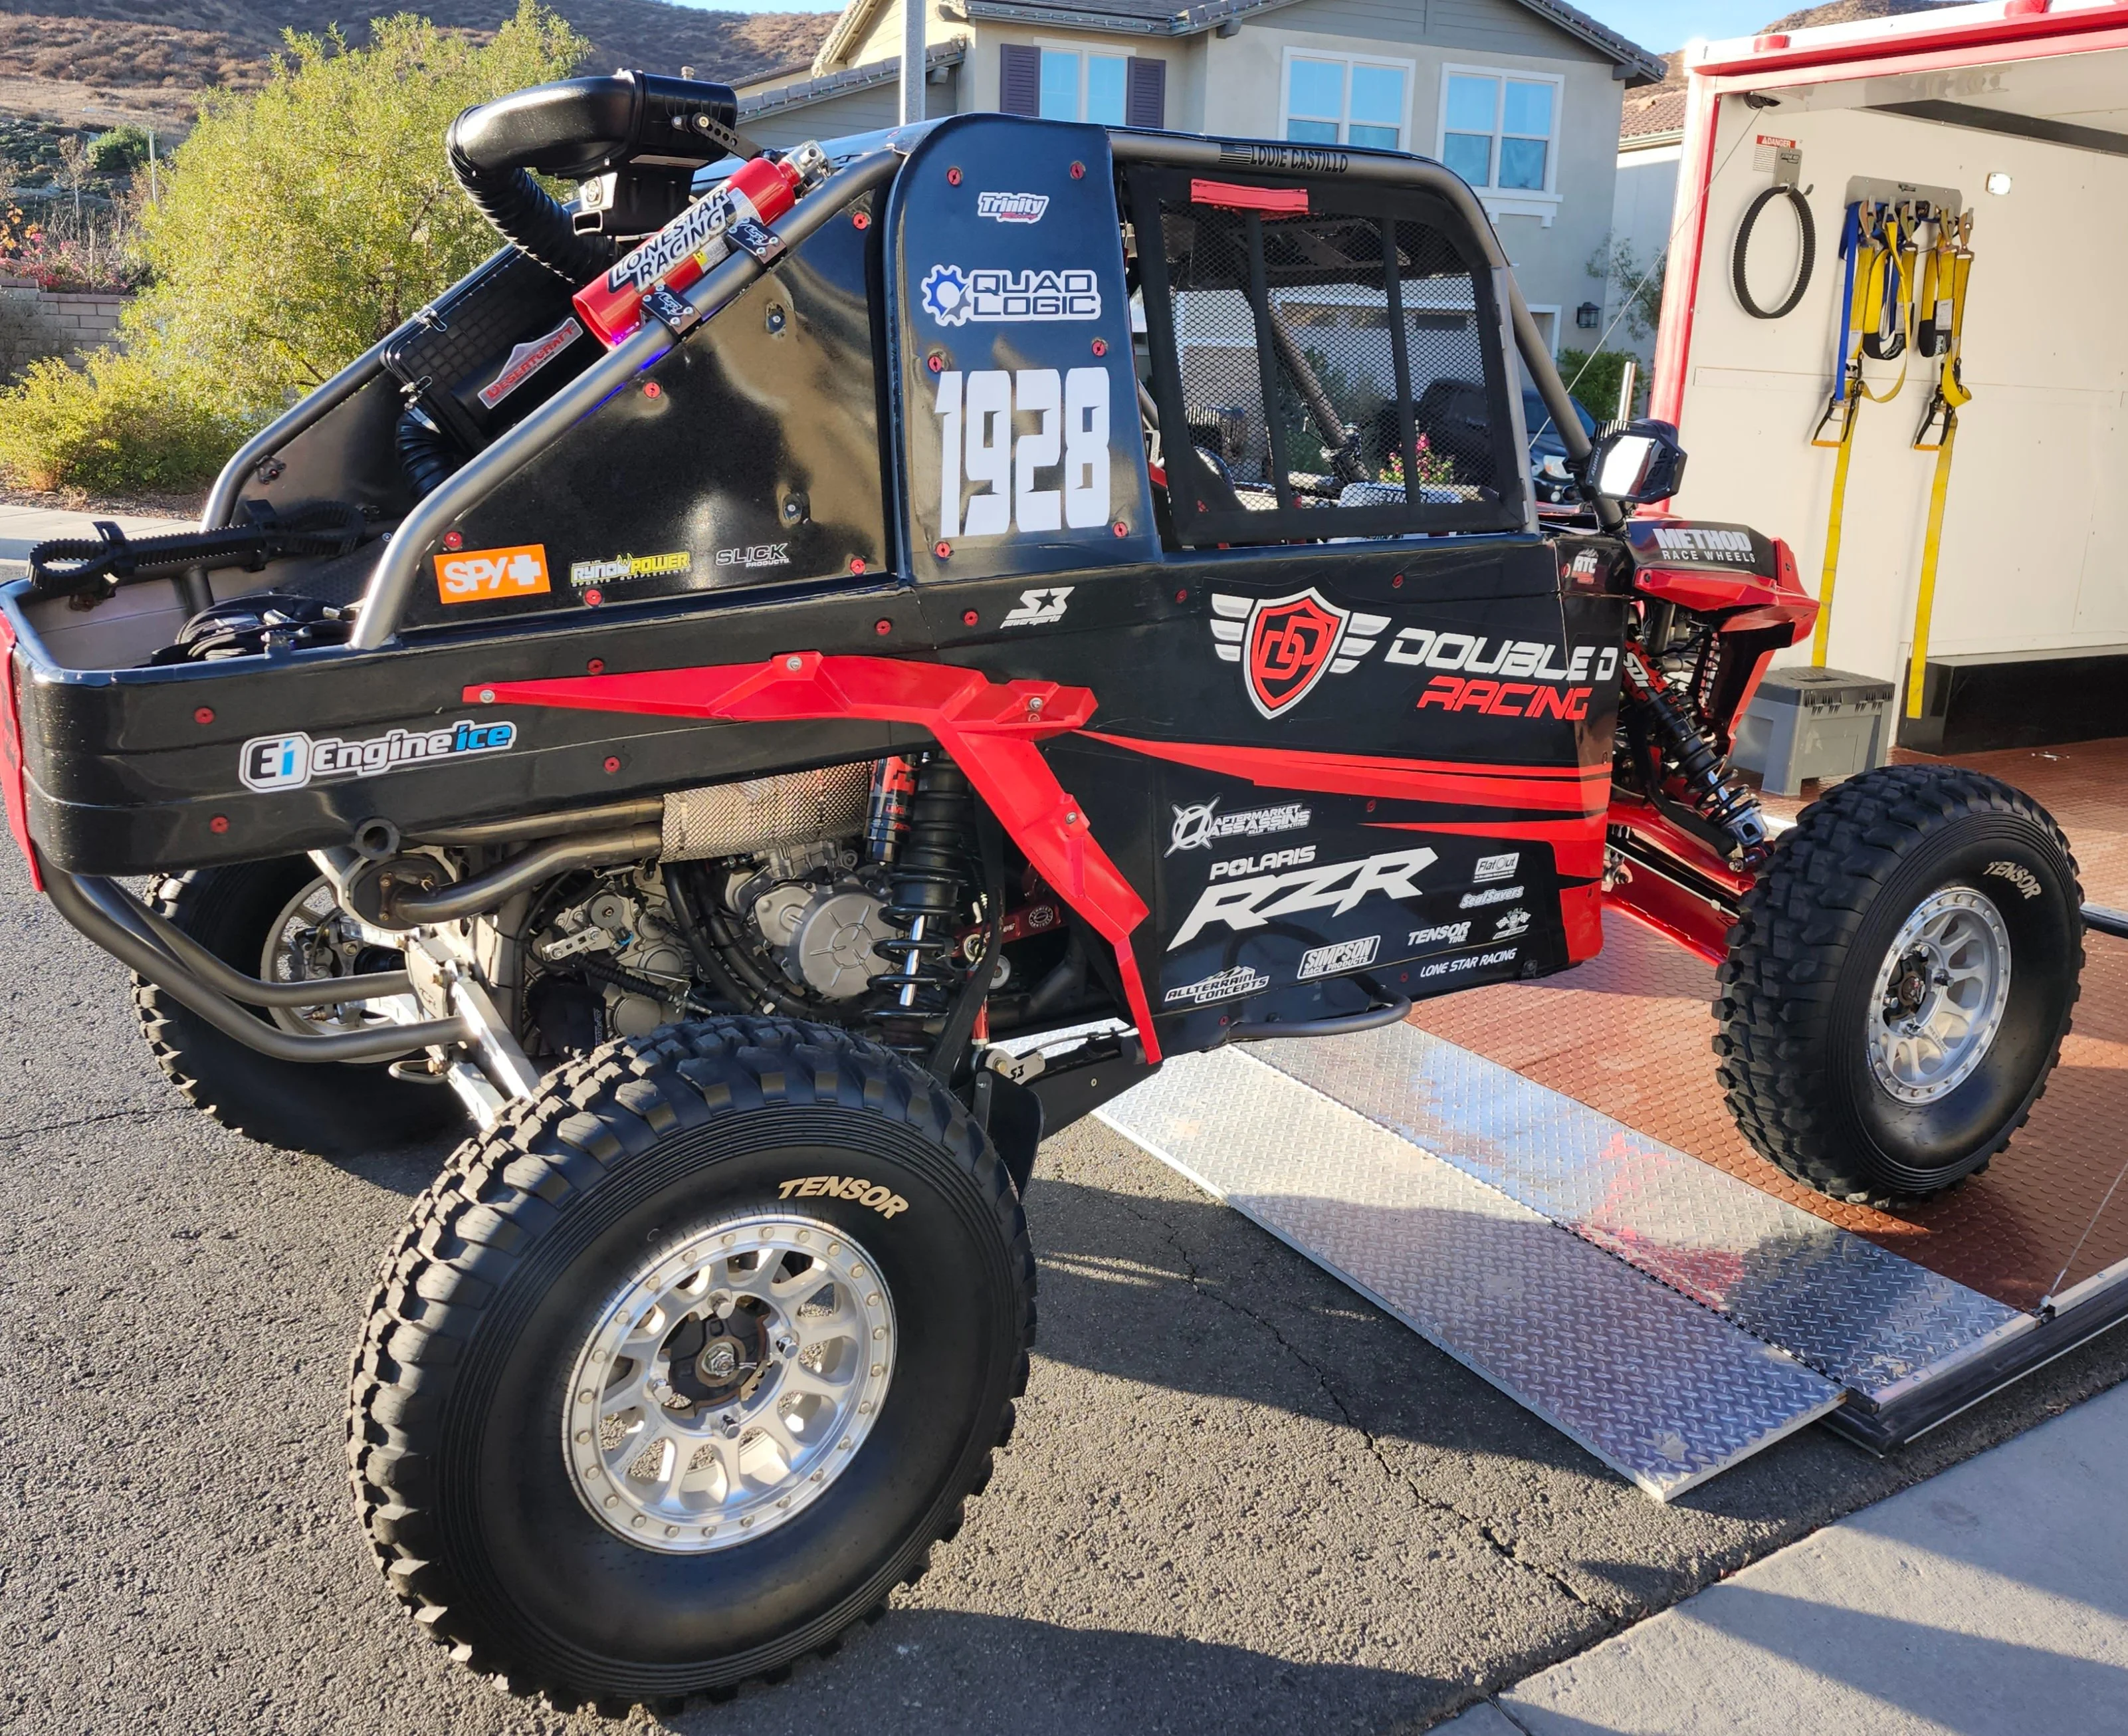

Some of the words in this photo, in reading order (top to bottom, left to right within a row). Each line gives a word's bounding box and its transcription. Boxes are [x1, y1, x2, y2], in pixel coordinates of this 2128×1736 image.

[1768, 138, 1790, 148] DANGER
[1251, 146, 1288, 167] LOUIE
[1291, 149, 1348, 173] CASTILLO
[982, 197, 1045, 214] Trinity
[636, 205, 726, 292] RACING
[972, 274, 1093, 296] QUAD
[973, 295, 1097, 316] LOGIC
[934, 367, 1111, 538] 1928
[1653, 528, 1753, 552] METHOD
[631, 553, 689, 574] POWER
[716, 542, 789, 566] SLICK
[745, 558, 790, 568] PRODUCTS
[1572, 555, 1598, 574] ATC
[1662, 550, 1699, 560] RACE
[1704, 551, 1756, 564] WHEELS
[1384, 627, 1596, 681] DOUBLE
[1595, 647, 1618, 681] D
[1416, 675, 1593, 720] RACING
[312, 734, 452, 772] Engine
[455, 724, 512, 751] ice
[1208, 810, 1311, 837] ASSASSINS
[1214, 805, 1301, 825] AFTERMARKET
[1210, 845, 1317, 881] POLARIS
[1982, 861, 2042, 899] TENSOR
[1166, 847, 1439, 952] RZR
[1408, 921, 1472, 946] TENSOR
[1447, 933, 1467, 944] TIRE
[1302, 966, 1325, 976] RACE
[1327, 956, 1369, 971] PRODUCTS
[1304, 938, 1375, 970] SIMPSON
[1420, 962, 1449, 978] LONE
[1449, 956, 1479, 972] STAR
[1479, 948, 1518, 967] RACING
[1167, 973, 1253, 1000] ALLTERRAIN
[1196, 977, 1267, 1002] CONCEPTS
[778, 1176, 910, 1220] TENSOR
